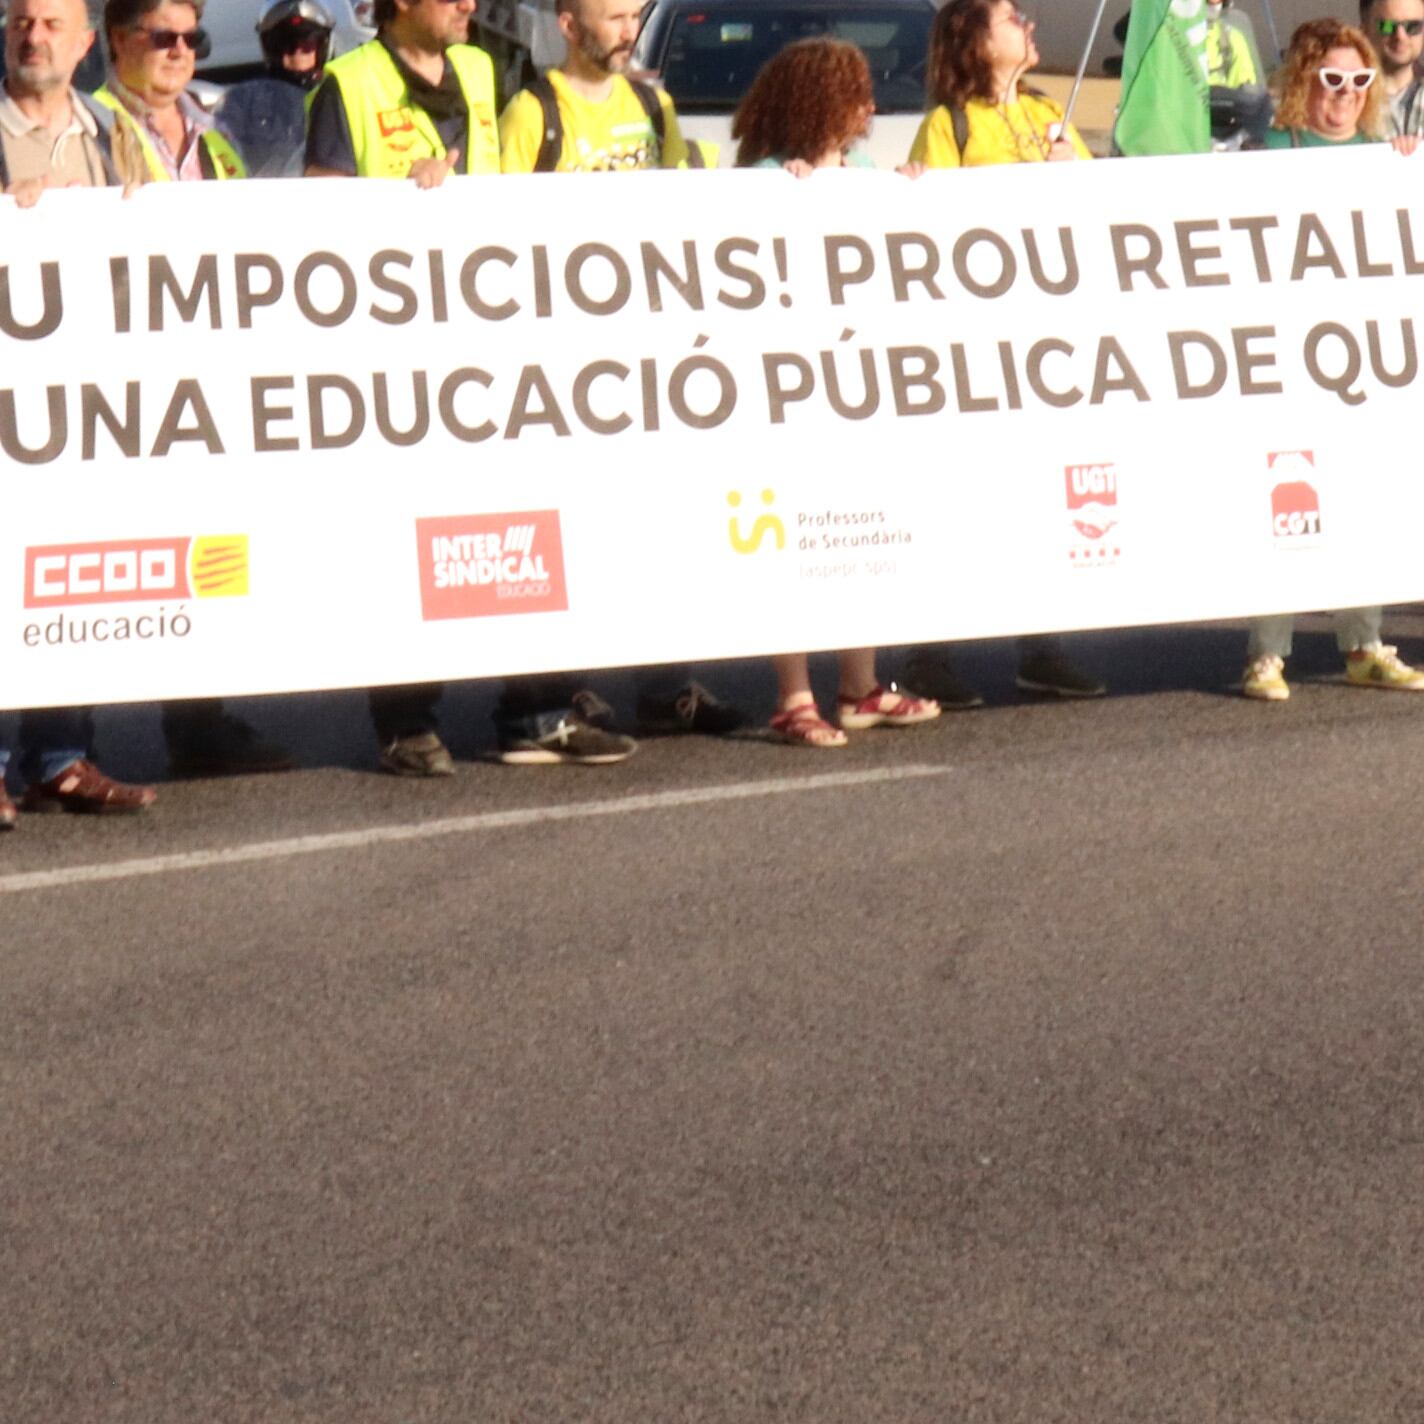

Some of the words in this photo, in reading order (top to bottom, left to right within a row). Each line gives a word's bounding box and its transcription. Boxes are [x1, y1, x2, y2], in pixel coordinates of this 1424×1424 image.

[110, 237, 792, 333] IMPOSICIONS!
[824, 227, 1079, 305] PROU
[251, 335, 737, 452] EDUCACIÓ
[762, 328, 1150, 423] PÚBLICA
[1168, 326, 1282, 399] DE
[1071, 465, 1116, 496] UGT
[798, 511, 886, 527] Professors
[1275, 510, 1319, 536] CGT
[432, 533, 502, 562] INTER
[799, 536, 817, 551] de
[822, 530, 912, 550] Secundària
[33, 548, 177, 597] CCOO
[434, 554, 550, 588] SINDICAL
[23, 604, 192, 647] educació
